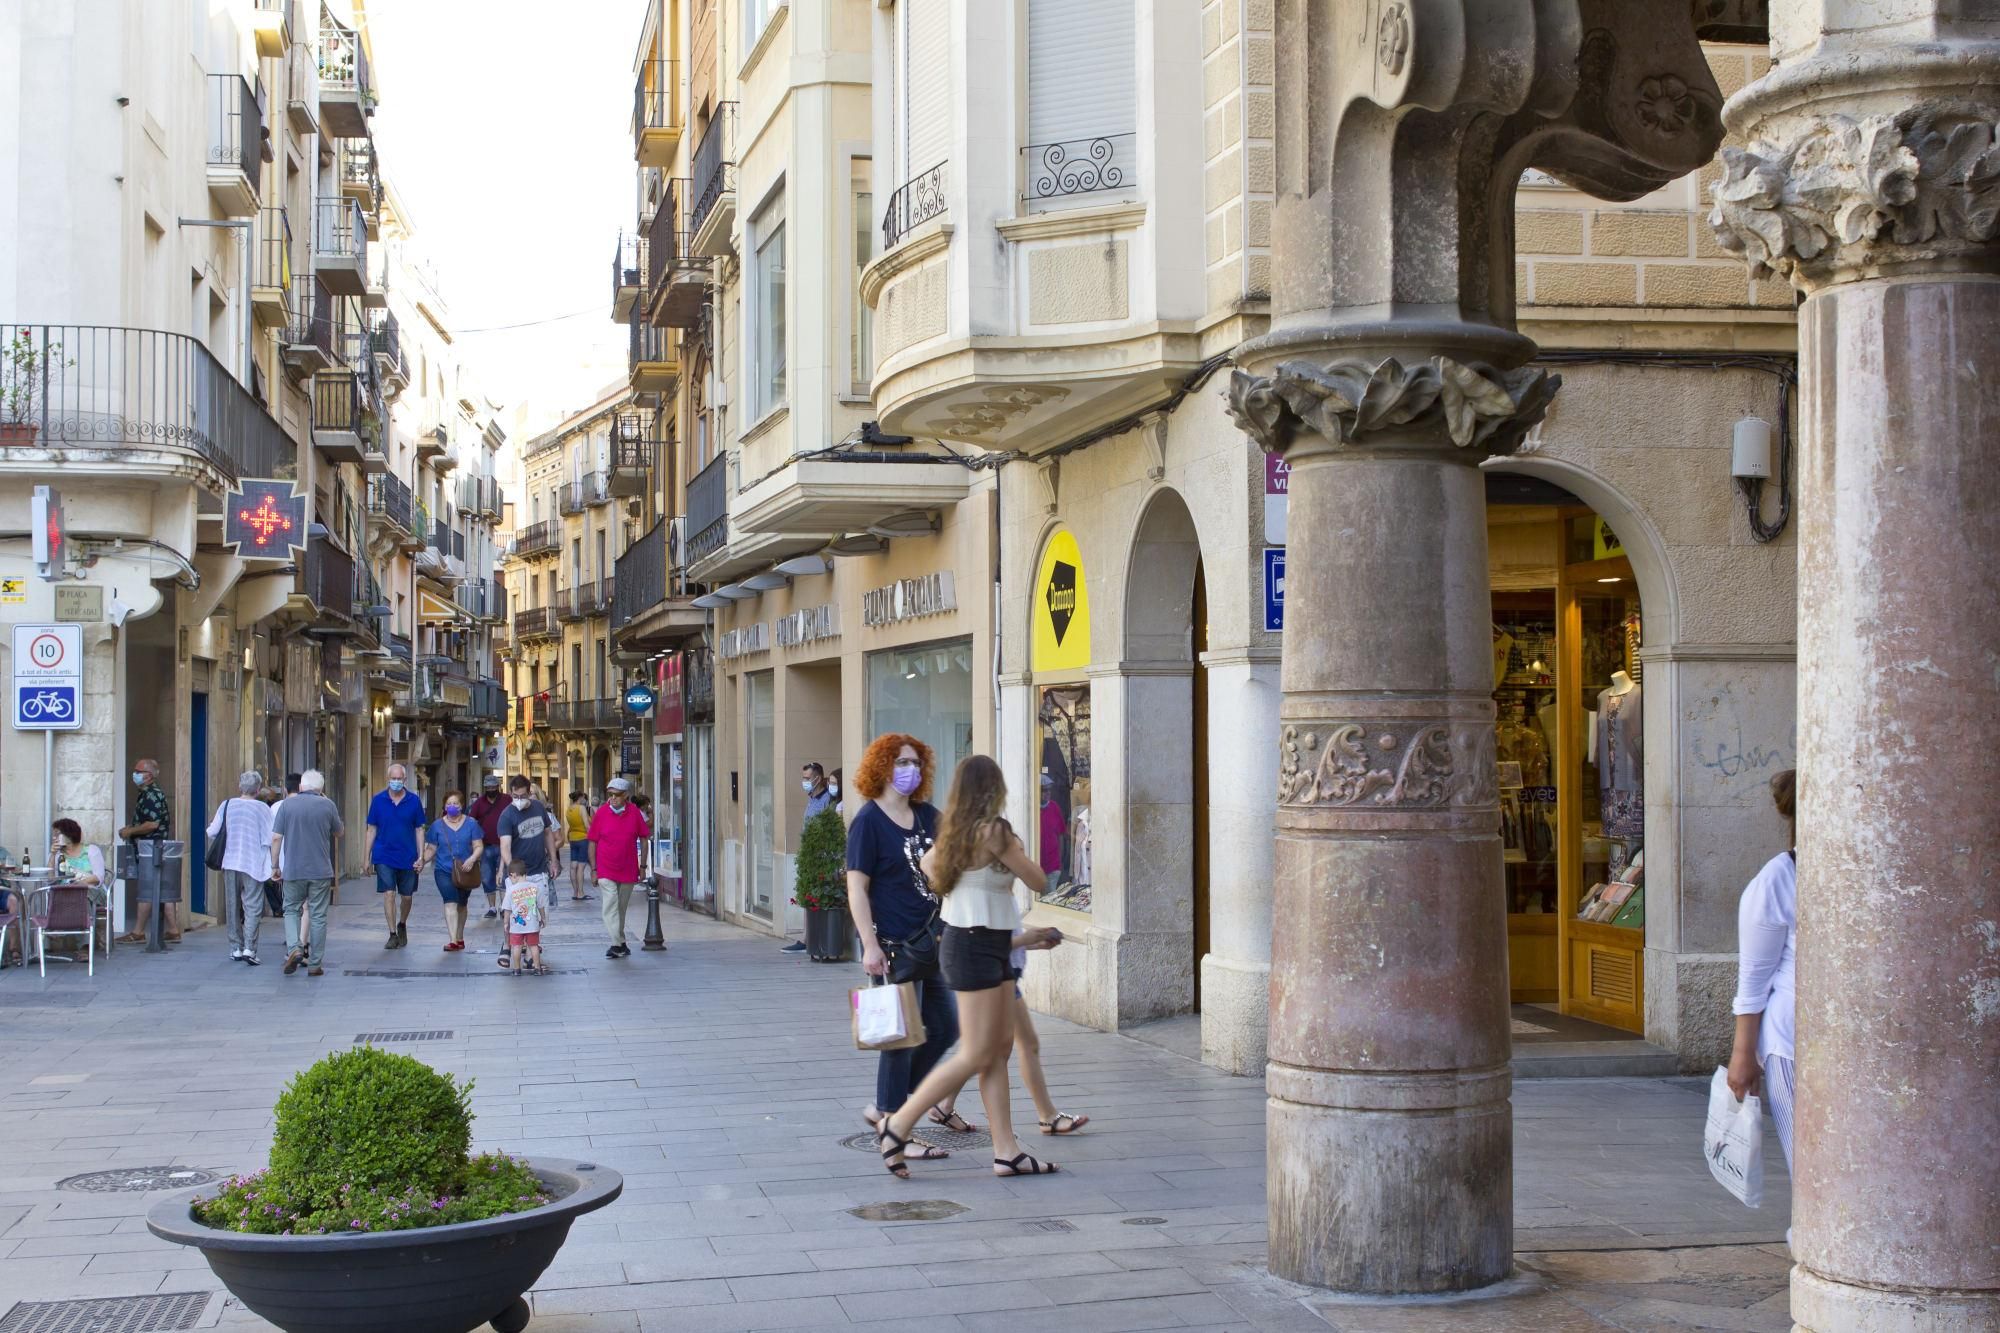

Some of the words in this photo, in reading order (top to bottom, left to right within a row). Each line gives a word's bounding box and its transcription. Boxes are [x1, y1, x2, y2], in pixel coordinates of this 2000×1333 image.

[1274, 479, 1288, 490] VI
[66, 591, 88, 600] PLAÇA
[1050, 582, 1075, 618] Domingo
[39, 644, 55, 658] 10
